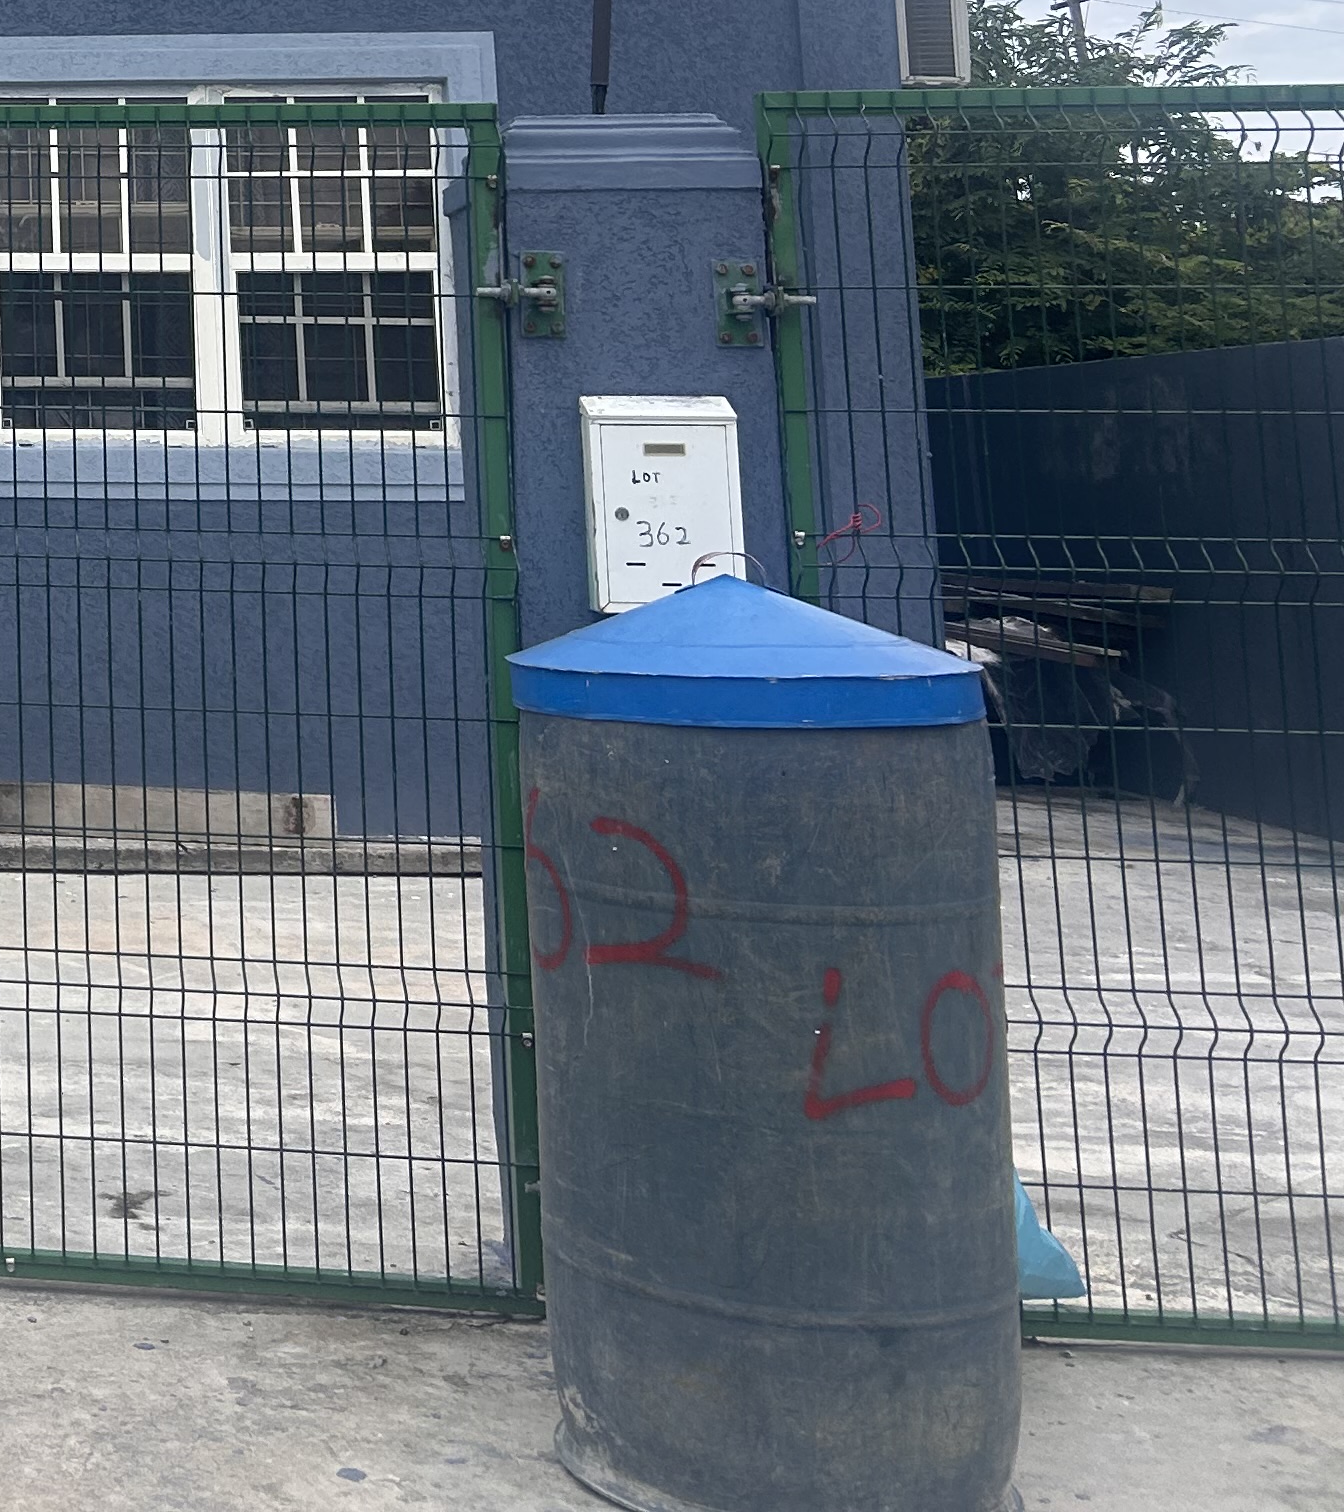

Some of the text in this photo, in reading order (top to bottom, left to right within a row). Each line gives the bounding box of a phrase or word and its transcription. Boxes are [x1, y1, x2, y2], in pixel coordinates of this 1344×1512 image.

[632, 469, 661, 484] LOT
[636, 520, 691, 548] 362
[804, 963, 1003, 1121] LO
